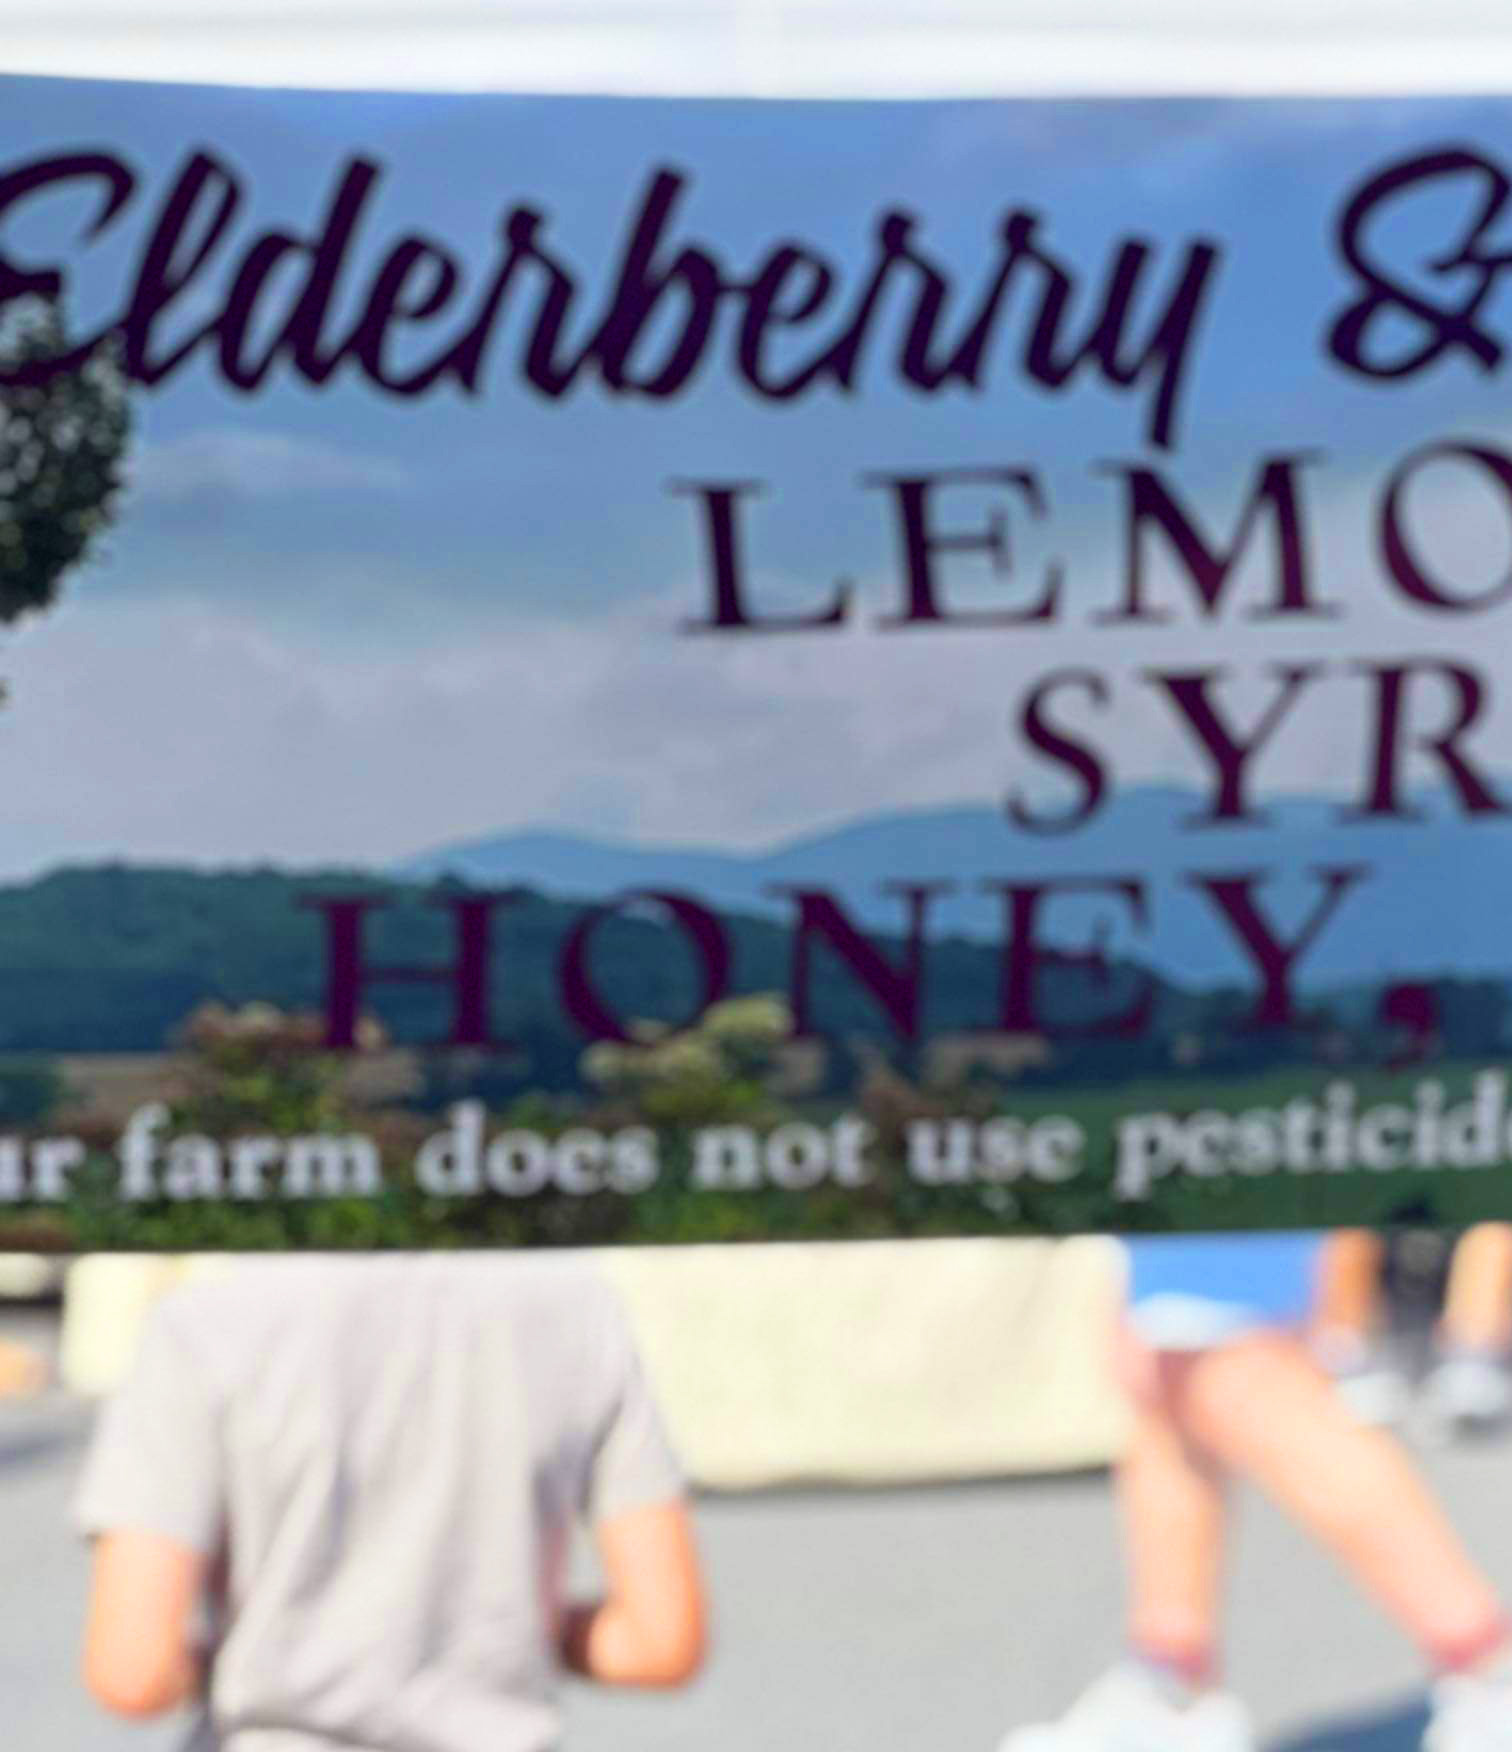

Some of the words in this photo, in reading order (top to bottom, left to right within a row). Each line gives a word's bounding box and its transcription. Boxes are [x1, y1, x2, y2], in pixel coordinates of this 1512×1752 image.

[0, 148, 1222, 452] Elderberry
[295, 862, 1440, 1073] HONEY,
[116, 1101, 382, 1201] farm
[413, 1098, 659, 1197] does
[692, 1112, 873, 1190] not
[906, 1112, 1088, 1186] use
